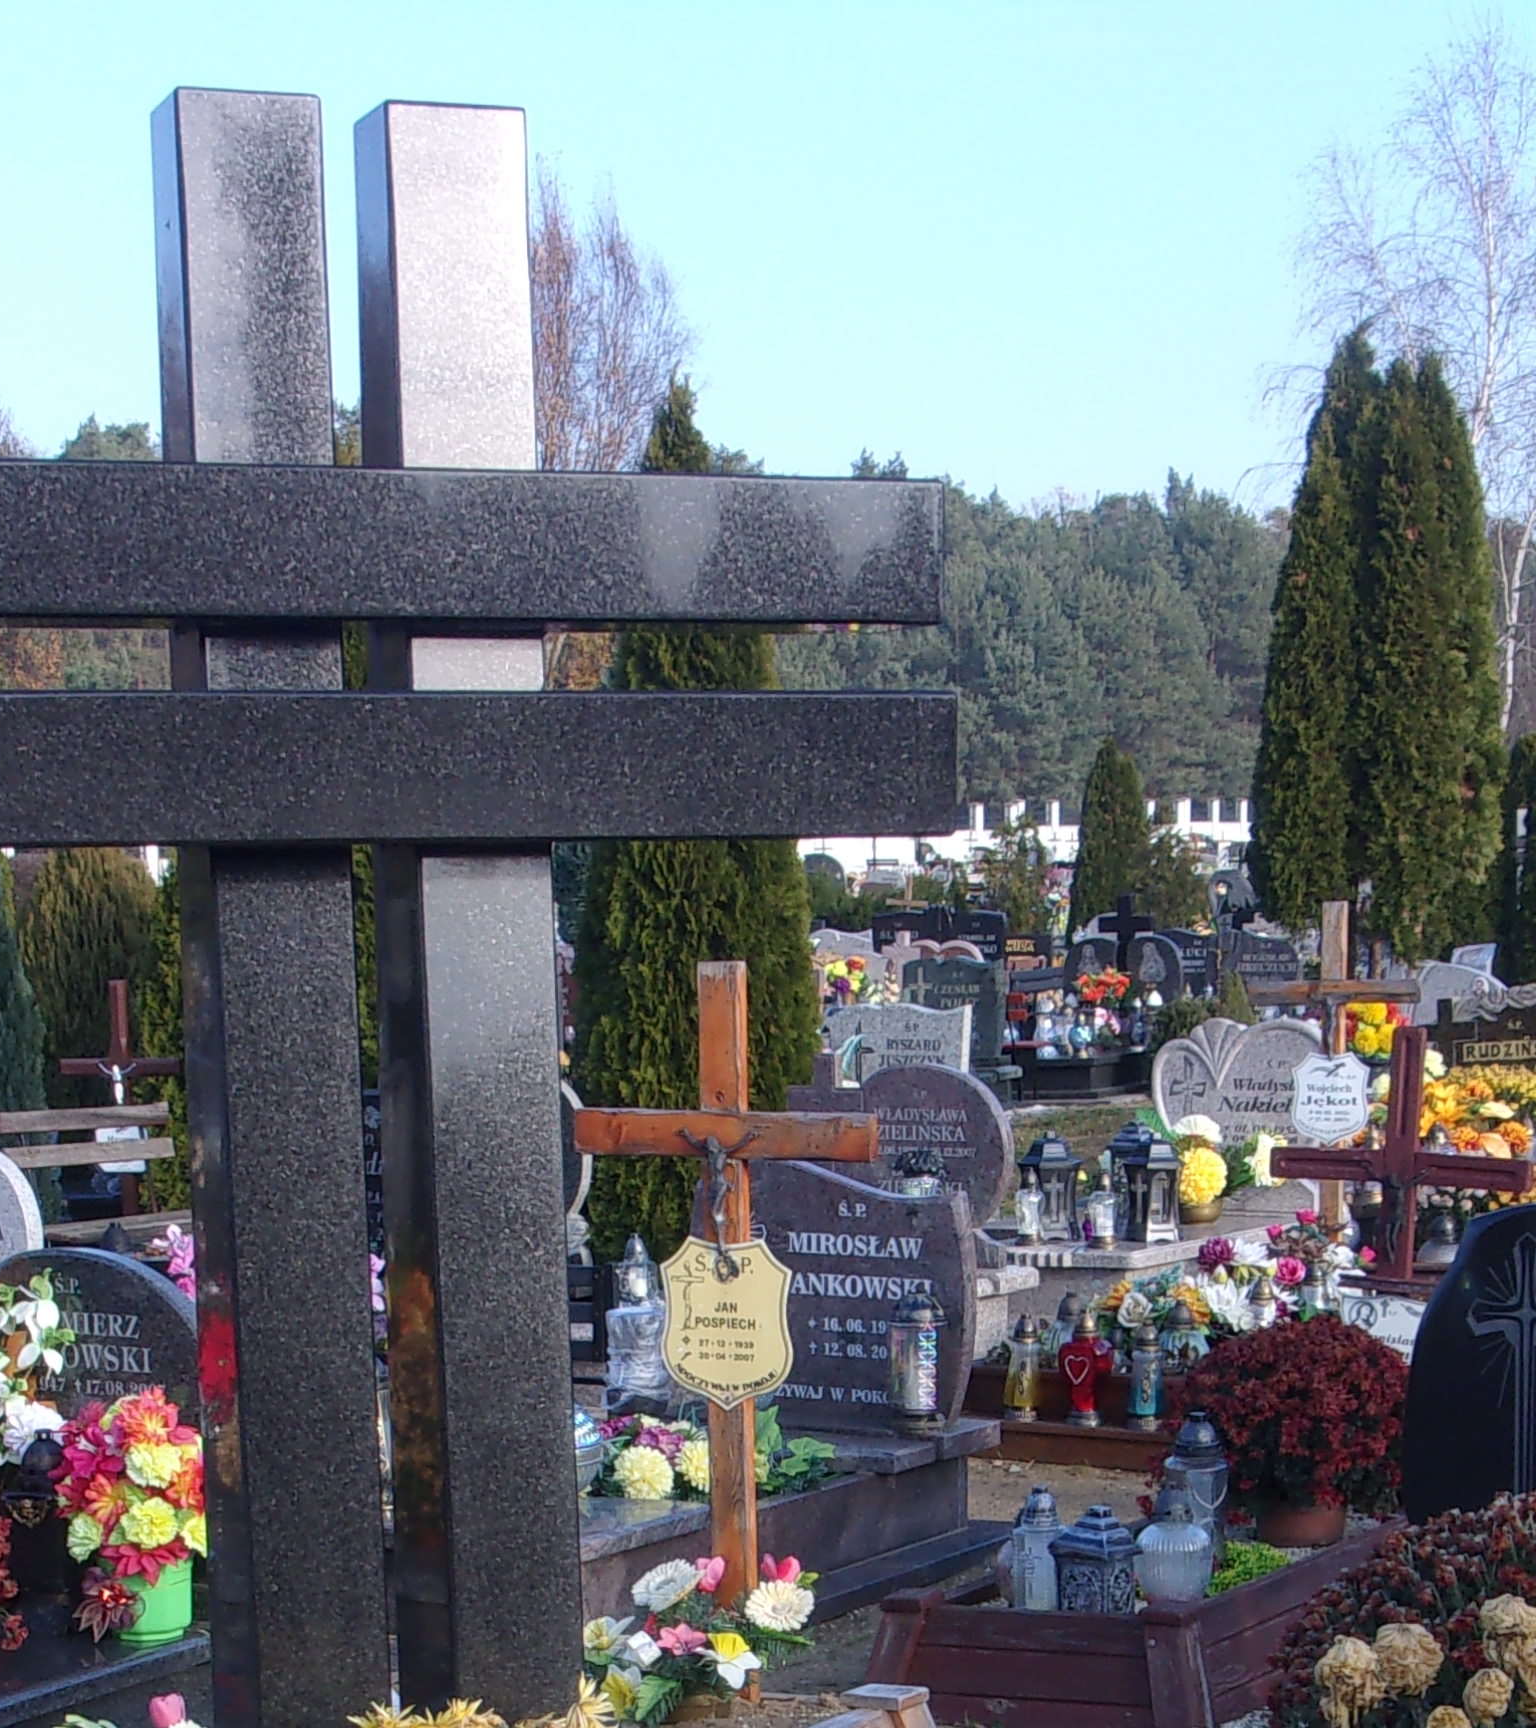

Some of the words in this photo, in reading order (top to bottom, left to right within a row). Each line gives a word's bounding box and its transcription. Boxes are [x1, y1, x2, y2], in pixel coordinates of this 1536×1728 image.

[885, 1038, 942, 1052] RYSZARD
[1217, 1096, 1292, 1114] Nakiel
[787, 1231, 924, 1261] MIROSŁAW
[790, 1272, 933, 1301] ANKOWSKI
[714, 1302, 738, 1313] JAN
[63, 1311, 141, 1340] MIERZ
[695, 1316, 757, 1330] POSPIECH
[870, 1320, 888, 1335] 19
[61, 1344, 153, 1374] OWSKI
[870, 1345, 888, 1360] 20
[775, 1384, 824, 1401] ZYWAJ
[830, 1387, 846, 1401] W
[851, 1389, 889, 1404] POK
